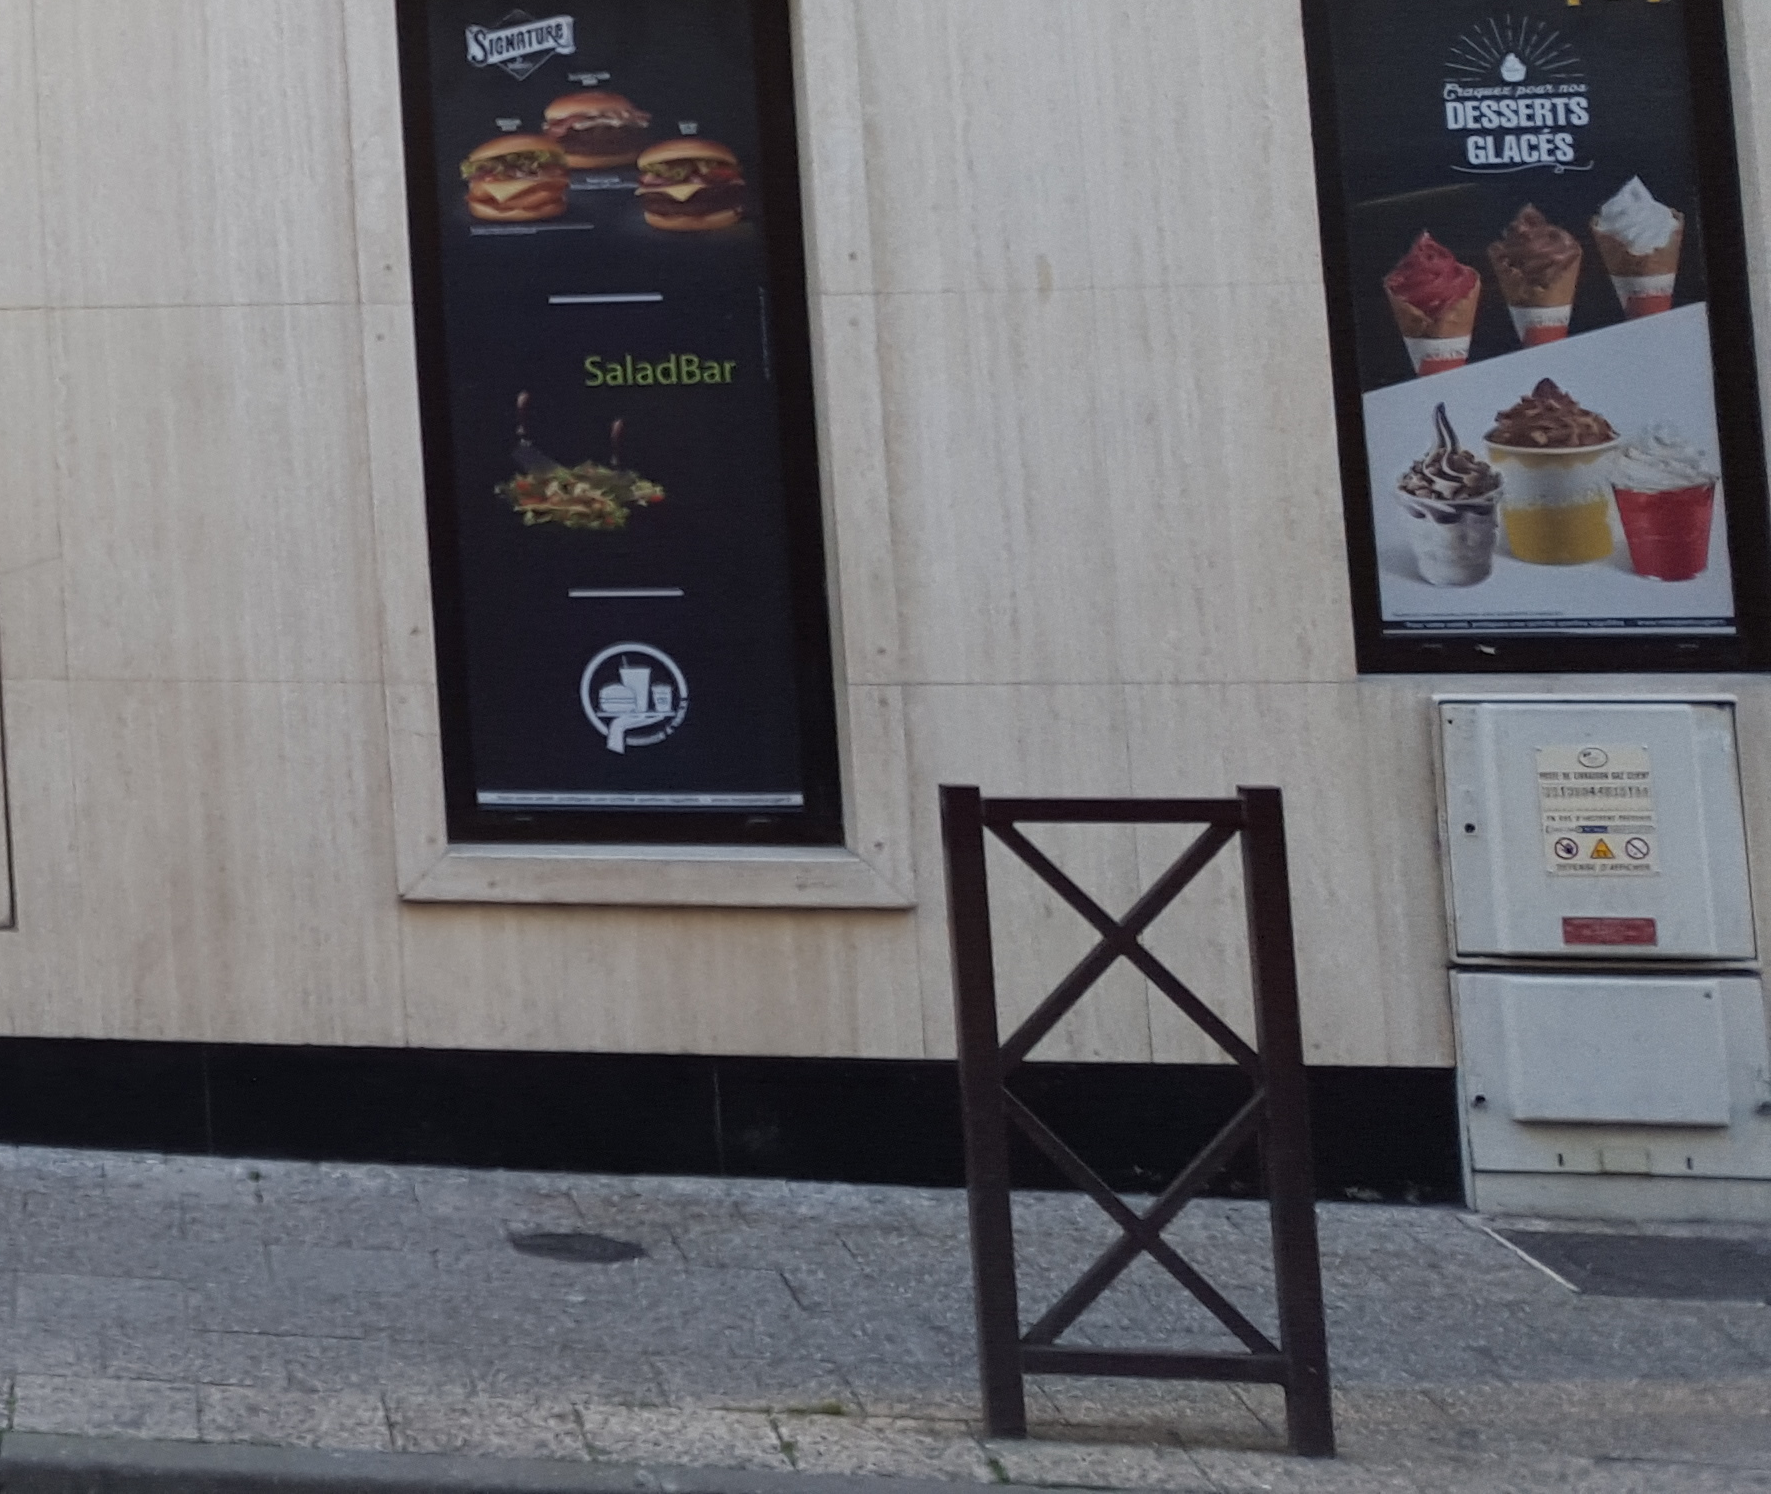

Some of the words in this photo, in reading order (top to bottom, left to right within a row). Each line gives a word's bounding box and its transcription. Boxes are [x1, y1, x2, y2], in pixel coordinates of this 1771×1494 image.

[472, 22, 564, 66] SIGNATURE
[1515, 84, 1555, 97] pour
[1558, 83, 1588, 93] nos
[1444, 96, 1590, 130] DESSERTS
[1467, 128, 1575, 165] GLACÉS
[584, 352, 736, 387] SaladBar
